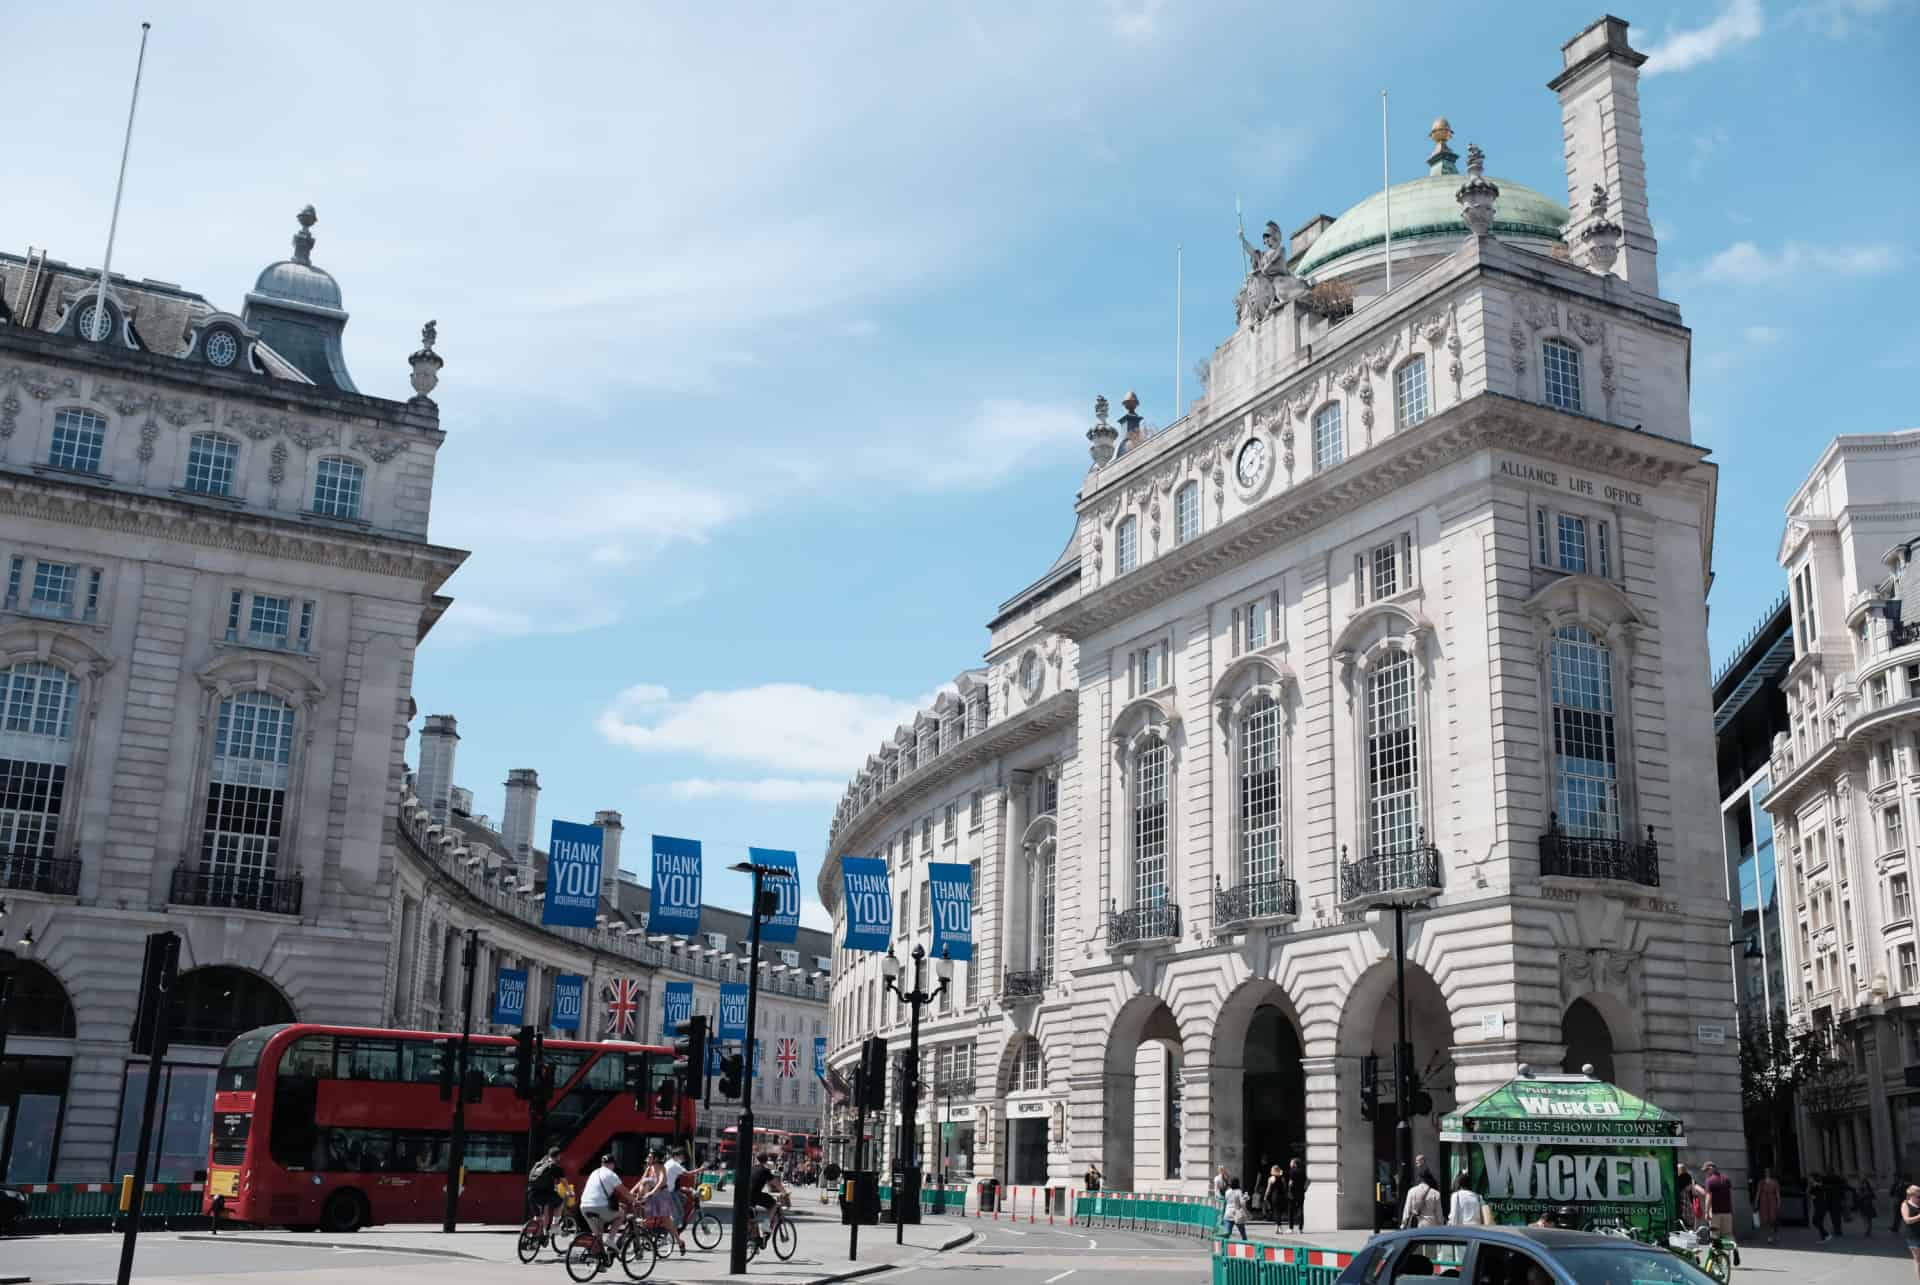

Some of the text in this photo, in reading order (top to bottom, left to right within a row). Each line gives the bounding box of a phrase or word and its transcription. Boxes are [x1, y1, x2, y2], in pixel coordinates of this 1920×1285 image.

[1501, 461, 1642, 506] ALLIANCE LIFE OFFICE
[553, 839, 600, 862] THANK
[655, 853, 699, 875] THANK
[554, 861, 599, 897] YOU
[846, 873, 888, 893] THANK
[657, 873, 700, 908] YOU
[932, 881, 970, 900] THANK
[851, 893, 890, 924] YOU
[936, 900, 971, 931] YOU
[500, 977, 525, 992] THANK
[557, 984, 580, 996] THANK
[500, 991, 525, 1009] YOU
[557, 996, 580, 1015] YOU
[667, 992, 690, 1004] THANK
[721, 994, 746, 1005] THANK
[667, 1003, 691, 1021] YOU
[722, 1005, 746, 1024] YOU
[1519, 1121, 1550, 1132] BEST
[1552, 1121, 1592, 1133] SHOW
[1596, 1122, 1610, 1133] IN
